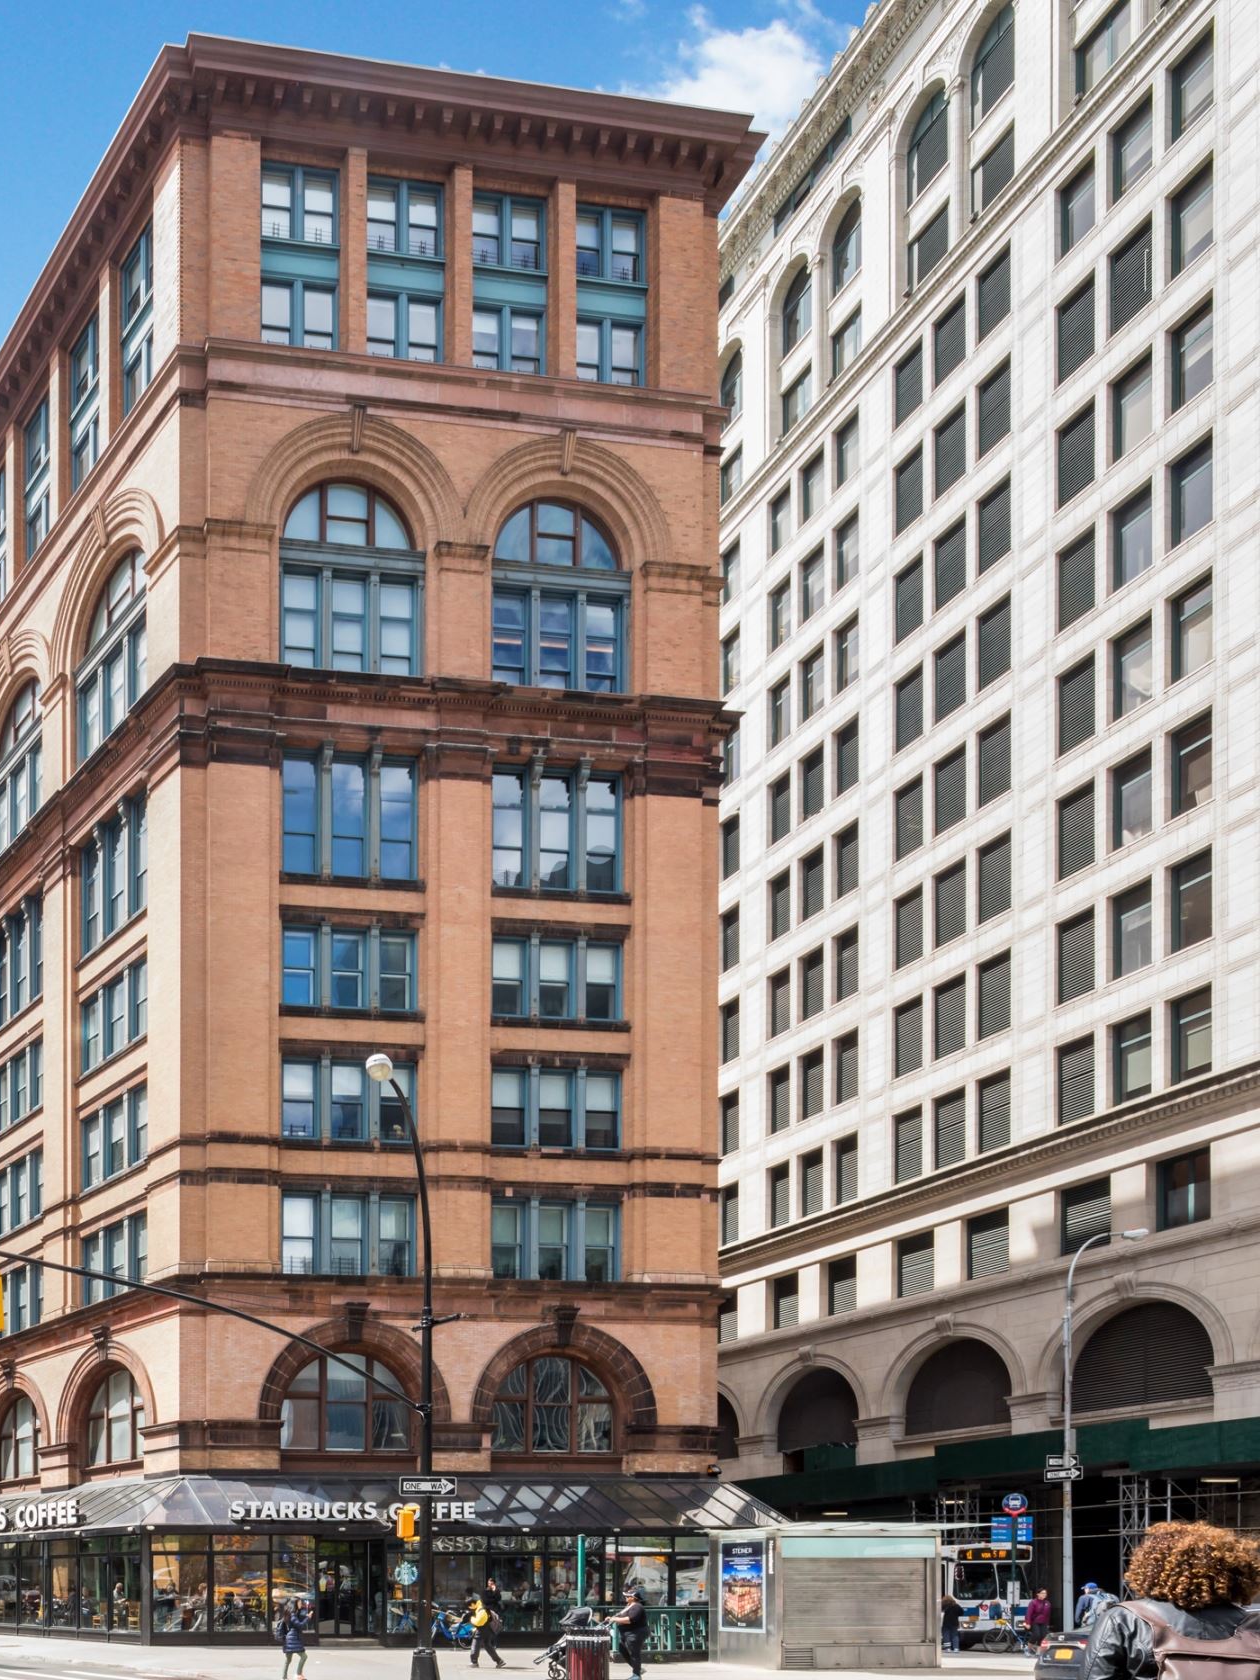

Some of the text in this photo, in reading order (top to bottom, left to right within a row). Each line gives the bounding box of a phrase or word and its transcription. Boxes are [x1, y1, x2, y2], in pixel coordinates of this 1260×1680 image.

[405, 1482, 449, 1490] ONE WAY
[15, 1499, 78, 1528] COFFEE
[230, 1501, 377, 1520] STARBUCKS
